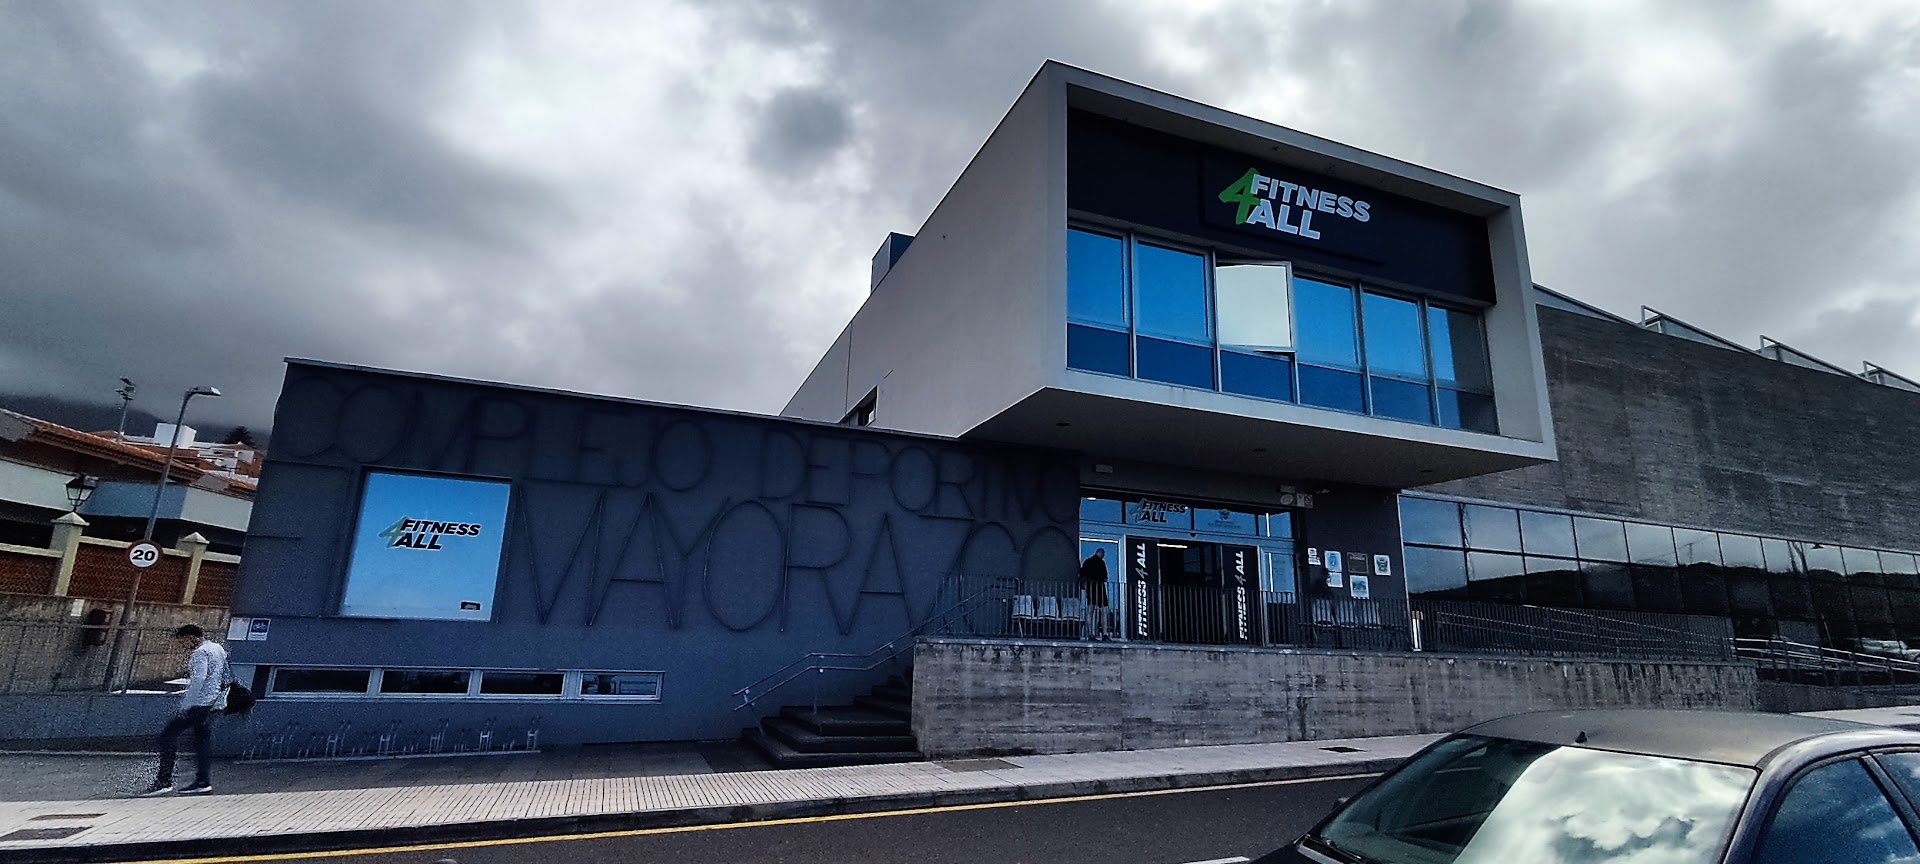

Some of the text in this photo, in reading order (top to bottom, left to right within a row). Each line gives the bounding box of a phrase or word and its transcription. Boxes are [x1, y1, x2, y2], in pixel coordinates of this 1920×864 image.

[1218, 167, 1371, 225] 4 FITNESS
[1247, 198, 1321, 240] ALL
[1140, 511, 1168, 523] ALL
[1142, 501, 1187, 513] FITNESS
[400, 519, 482, 536] FITNESS
[392, 532, 442, 550] ALL
[132, 549, 155, 561] 20
[1137, 543, 1146, 568] ALL
[1235, 551, 1244, 575] ALL
[1137, 579, 1147, 636] FITNESS
[1237, 586, 1247, 640] FITNESS
